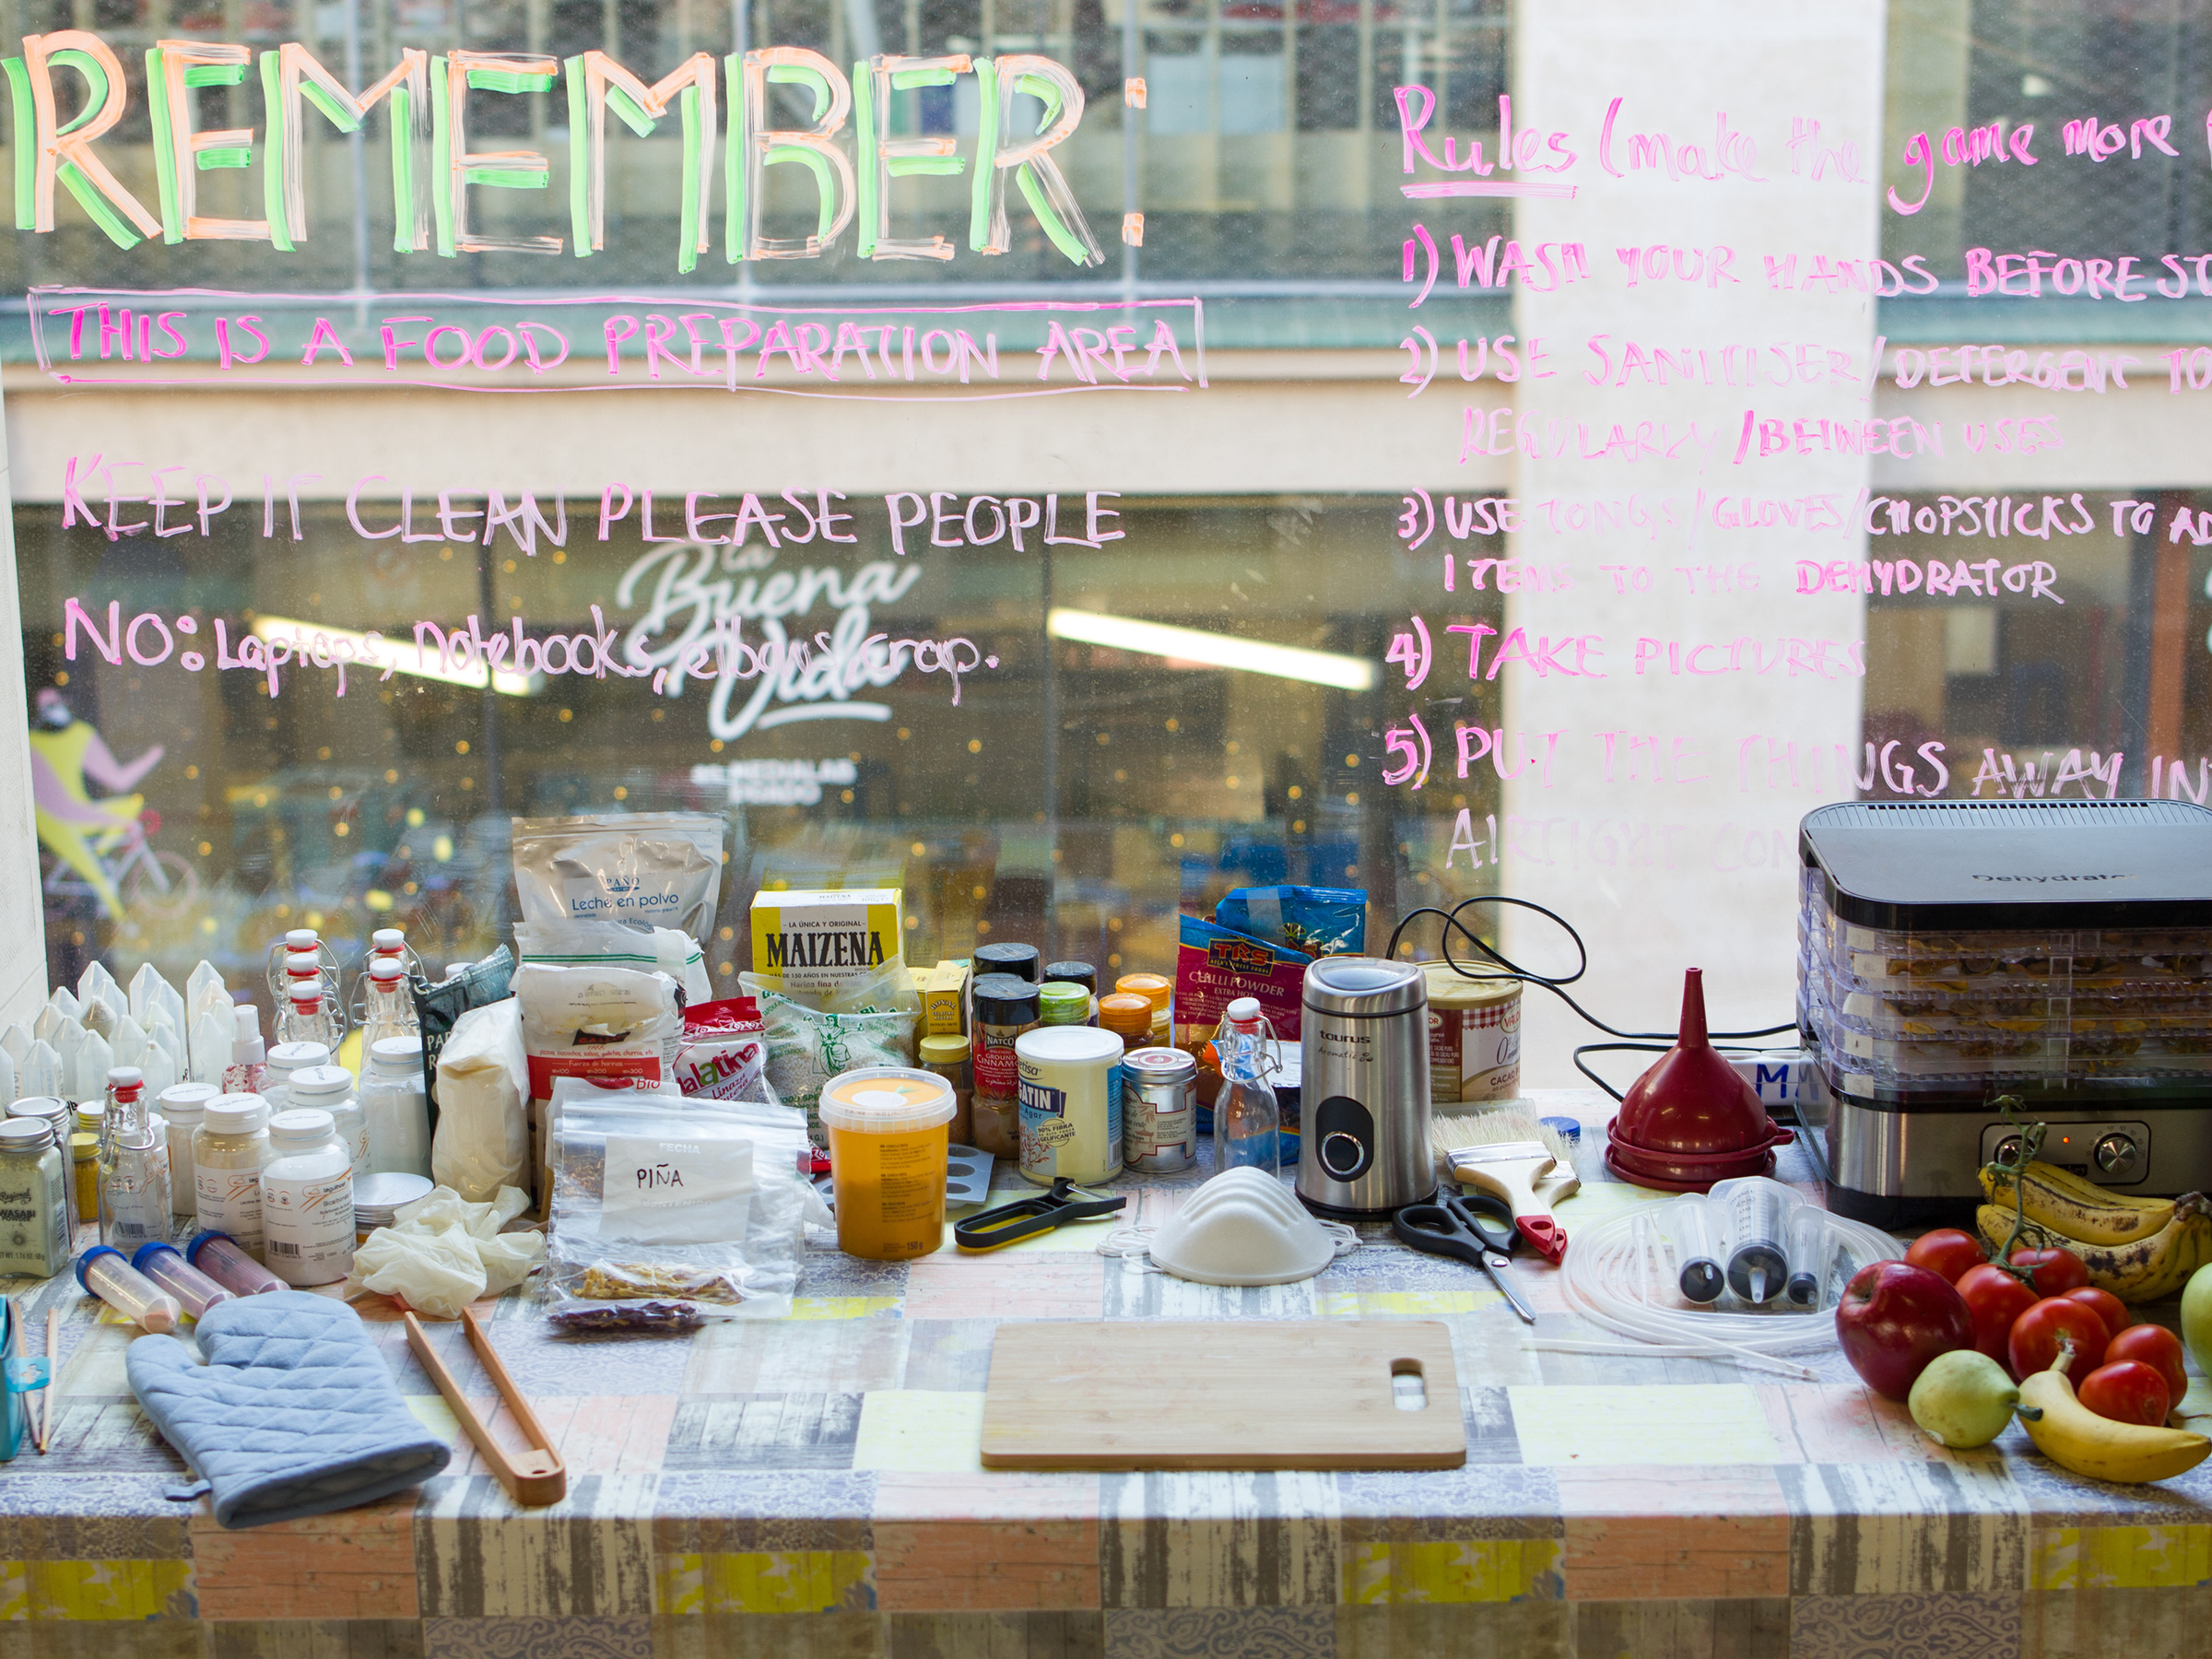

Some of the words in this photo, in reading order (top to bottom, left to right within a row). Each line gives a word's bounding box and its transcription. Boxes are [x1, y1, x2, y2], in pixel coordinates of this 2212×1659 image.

[1394, 84, 1579, 176] Rules
[1887, 123, 2039, 216] game
[2063, 115, 2181, 162] more
[1616, 244, 1741, 288] YOUR
[1763, 253, 1939, 297] HANDS
[1964, 247, 2147, 302] BEFORE
[49, 301, 188, 363] THIS
[216, 315, 270, 370] IS
[302, 318, 353, 367] A
[381, 315, 570, 376] FOOD
[604, 313, 999, 392] PREPARATION
[1036, 320, 1193, 383] AREA
[1457, 335, 1558, 383] USE
[1964, 414, 2065, 455] USES
[62, 453, 232, 540] KEEP
[264, 473, 324, 541] IT
[346, 475, 567, 557] CLEAN
[598, 482, 858, 547] PLEASE
[885, 490, 1126, 556] PEOPLE
[1444, 496, 1528, 540] USE
[2110, 500, 2155, 537] TO
[1599, 564, 1654, 595] TO
[1673, 561, 1760, 594] THE
[1794, 559, 2065, 605] DEHYDRATOR
[1444, 623, 1608, 681] TAKE
[1634, 636, 1866, 680] PICTURES
[1456, 725, 1571, 789] PUT
[1592, 730, 1712, 783] THE
[1735, 735, 1949, 798] THINGS
[1971, 748, 2124, 799] AWAY
[571, 897, 612, 911] Leche
[617, 897, 635, 908] en
[639, 892, 679, 909] polvo
[799, 920, 820, 928] ÚNICA
[765, 931, 885, 968] MAIZENA
[1215, 943, 1268, 966] TRS
[1189, 971, 1228, 985] CHILLI
[1230, 977, 1285, 997] POWDER
[1214, 987, 1235, 995] EXTRA
[1504, 1011, 1520, 1028] VALO
[987, 1036, 1015, 1046] NATCO
[1319, 1030, 1371, 1043] taurus
[977, 1054, 1018, 1067] CINNAMO
[1318, 1046, 1358, 1059] Aromatic
[1018, 1062, 1040, 1077] etisa
[1040, 1131, 1076, 1142] GELIFICANTE
[1053, 1123, 1073, 1131] FIBRA
[659, 1143, 700, 1154] FECHA
[637, 1163, 684, 1189] PIÑA
[0, 1209, 36, 1218] WASABI
